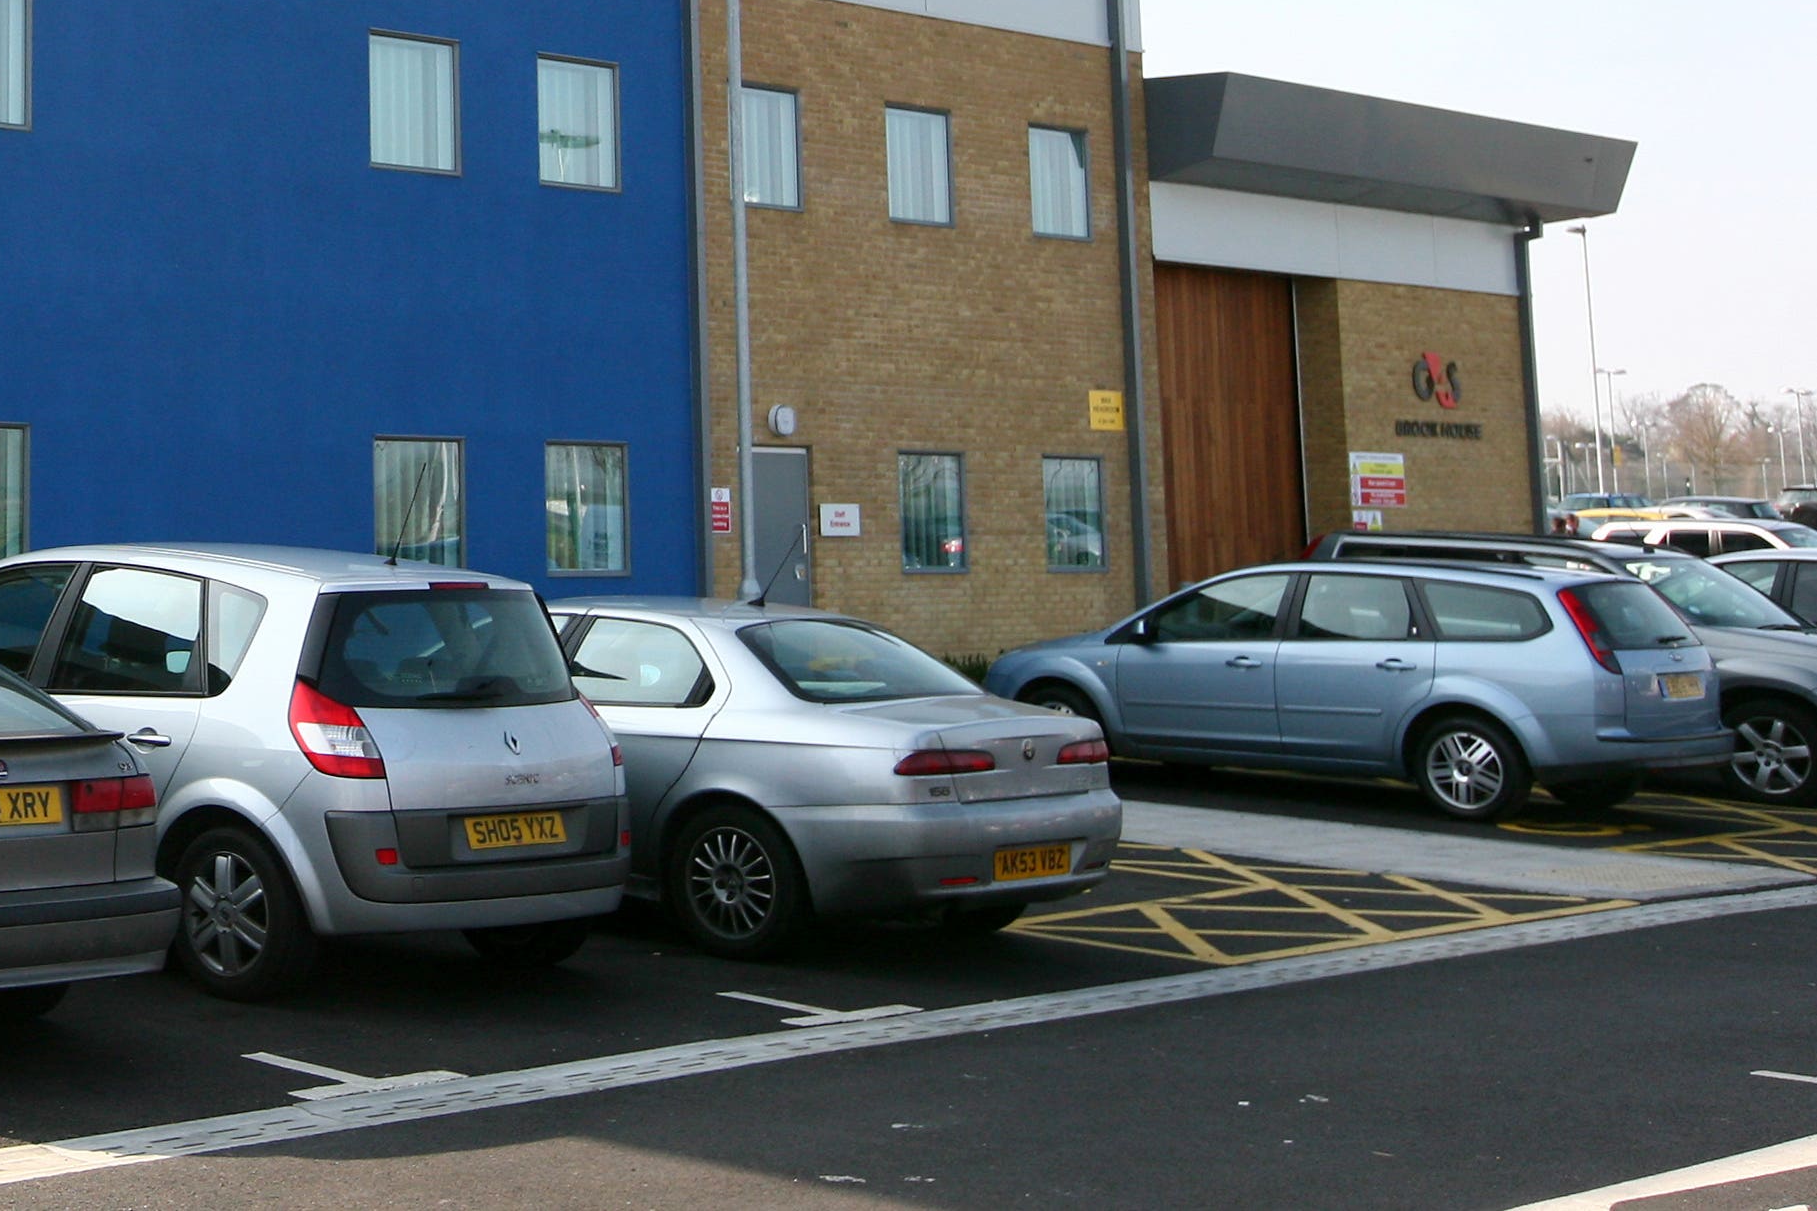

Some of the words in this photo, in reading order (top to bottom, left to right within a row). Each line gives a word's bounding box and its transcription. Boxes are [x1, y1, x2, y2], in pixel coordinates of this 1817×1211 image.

[1395, 419, 1438, 438] BROOK
[1440, 421, 1482, 440] HOUSE
[7, 791, 52, 820] XRY
[472, 817, 523, 844] SH05
[524, 815, 559, 840] YXZ
[1001, 851, 1036, 876] AK53
[1040, 848, 1065, 871] VBZ
